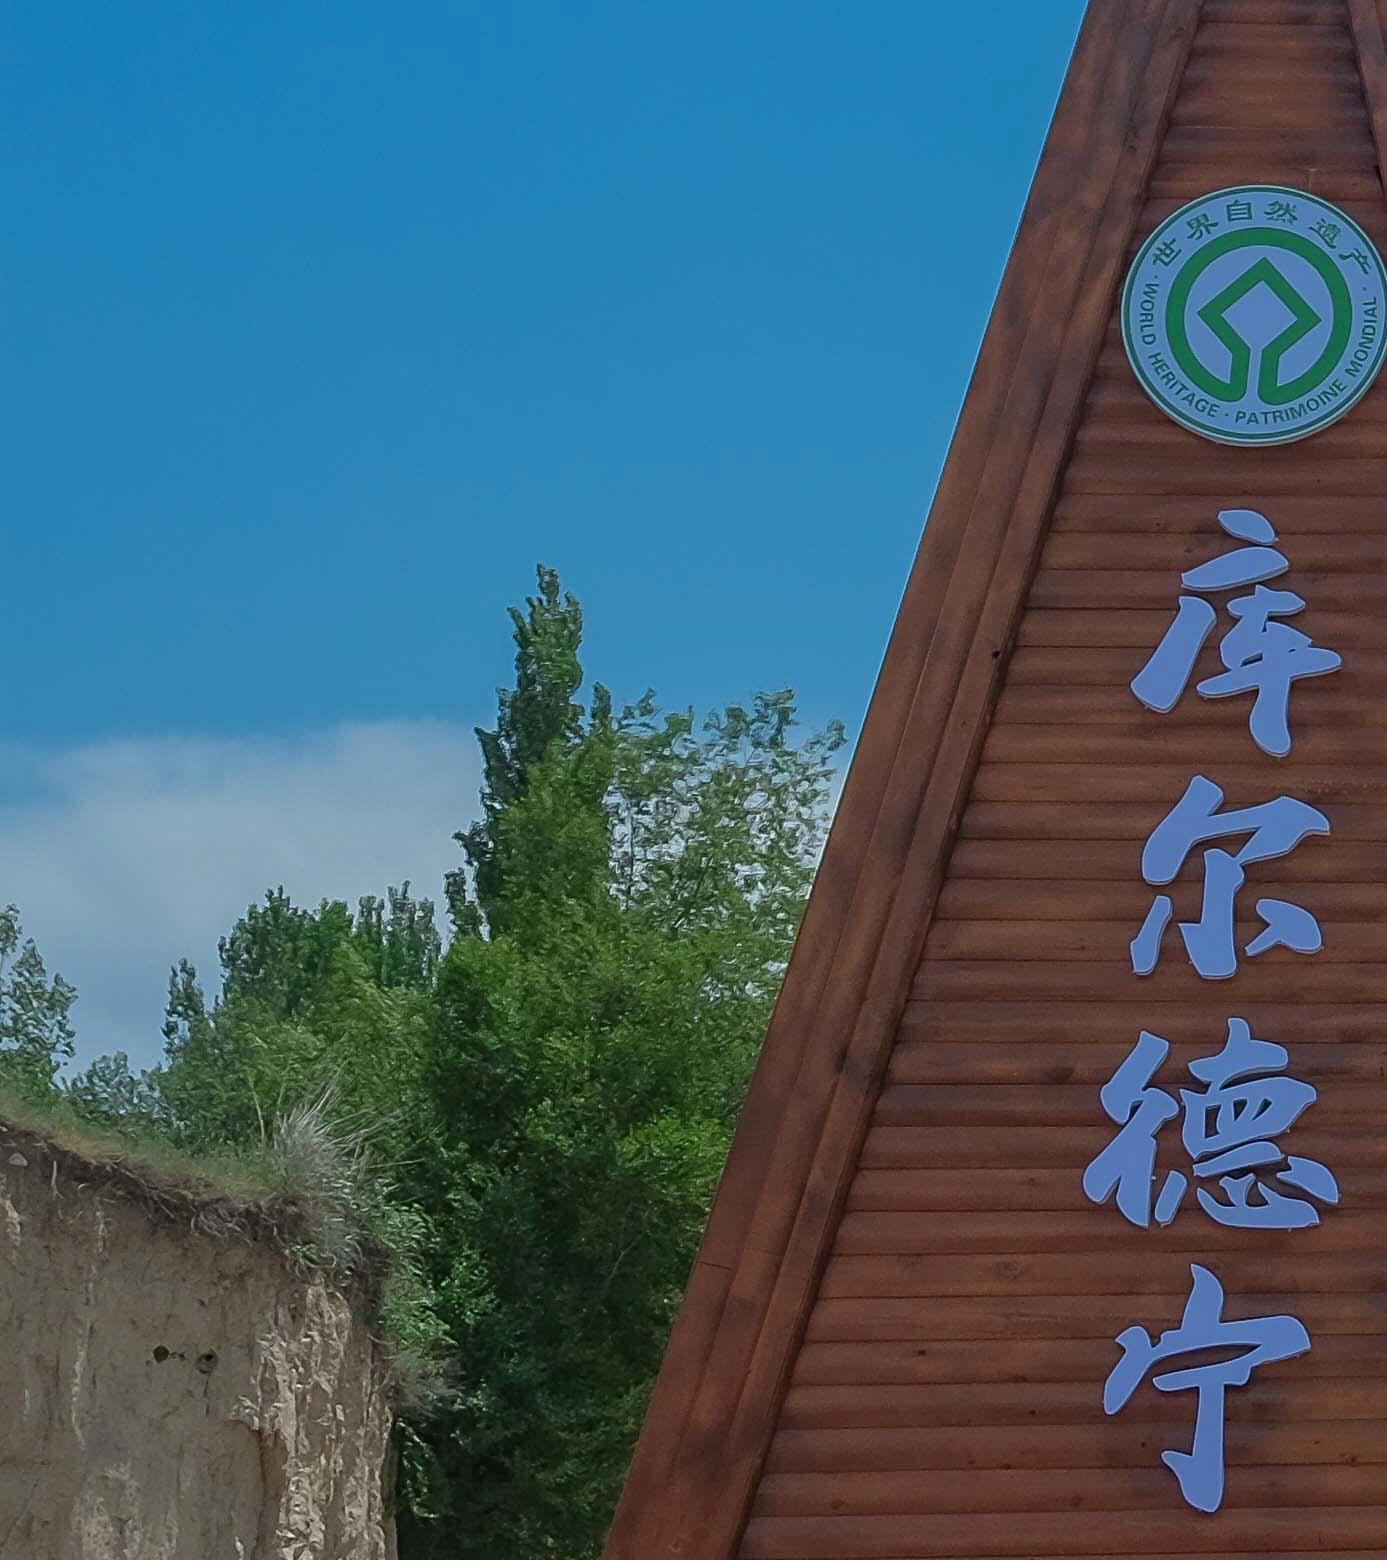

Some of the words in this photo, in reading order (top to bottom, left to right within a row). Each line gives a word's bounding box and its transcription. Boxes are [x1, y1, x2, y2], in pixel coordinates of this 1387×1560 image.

[1138, 282, 1160, 346] WORLD
[1234, 378, 1348, 425] PATRIMOINE
[1345, 295, 1377, 378] MONDIAL
[1147, 351, 1221, 418] HERITAGE
[1083, 509, 1342, 1514] 库尔德宁
